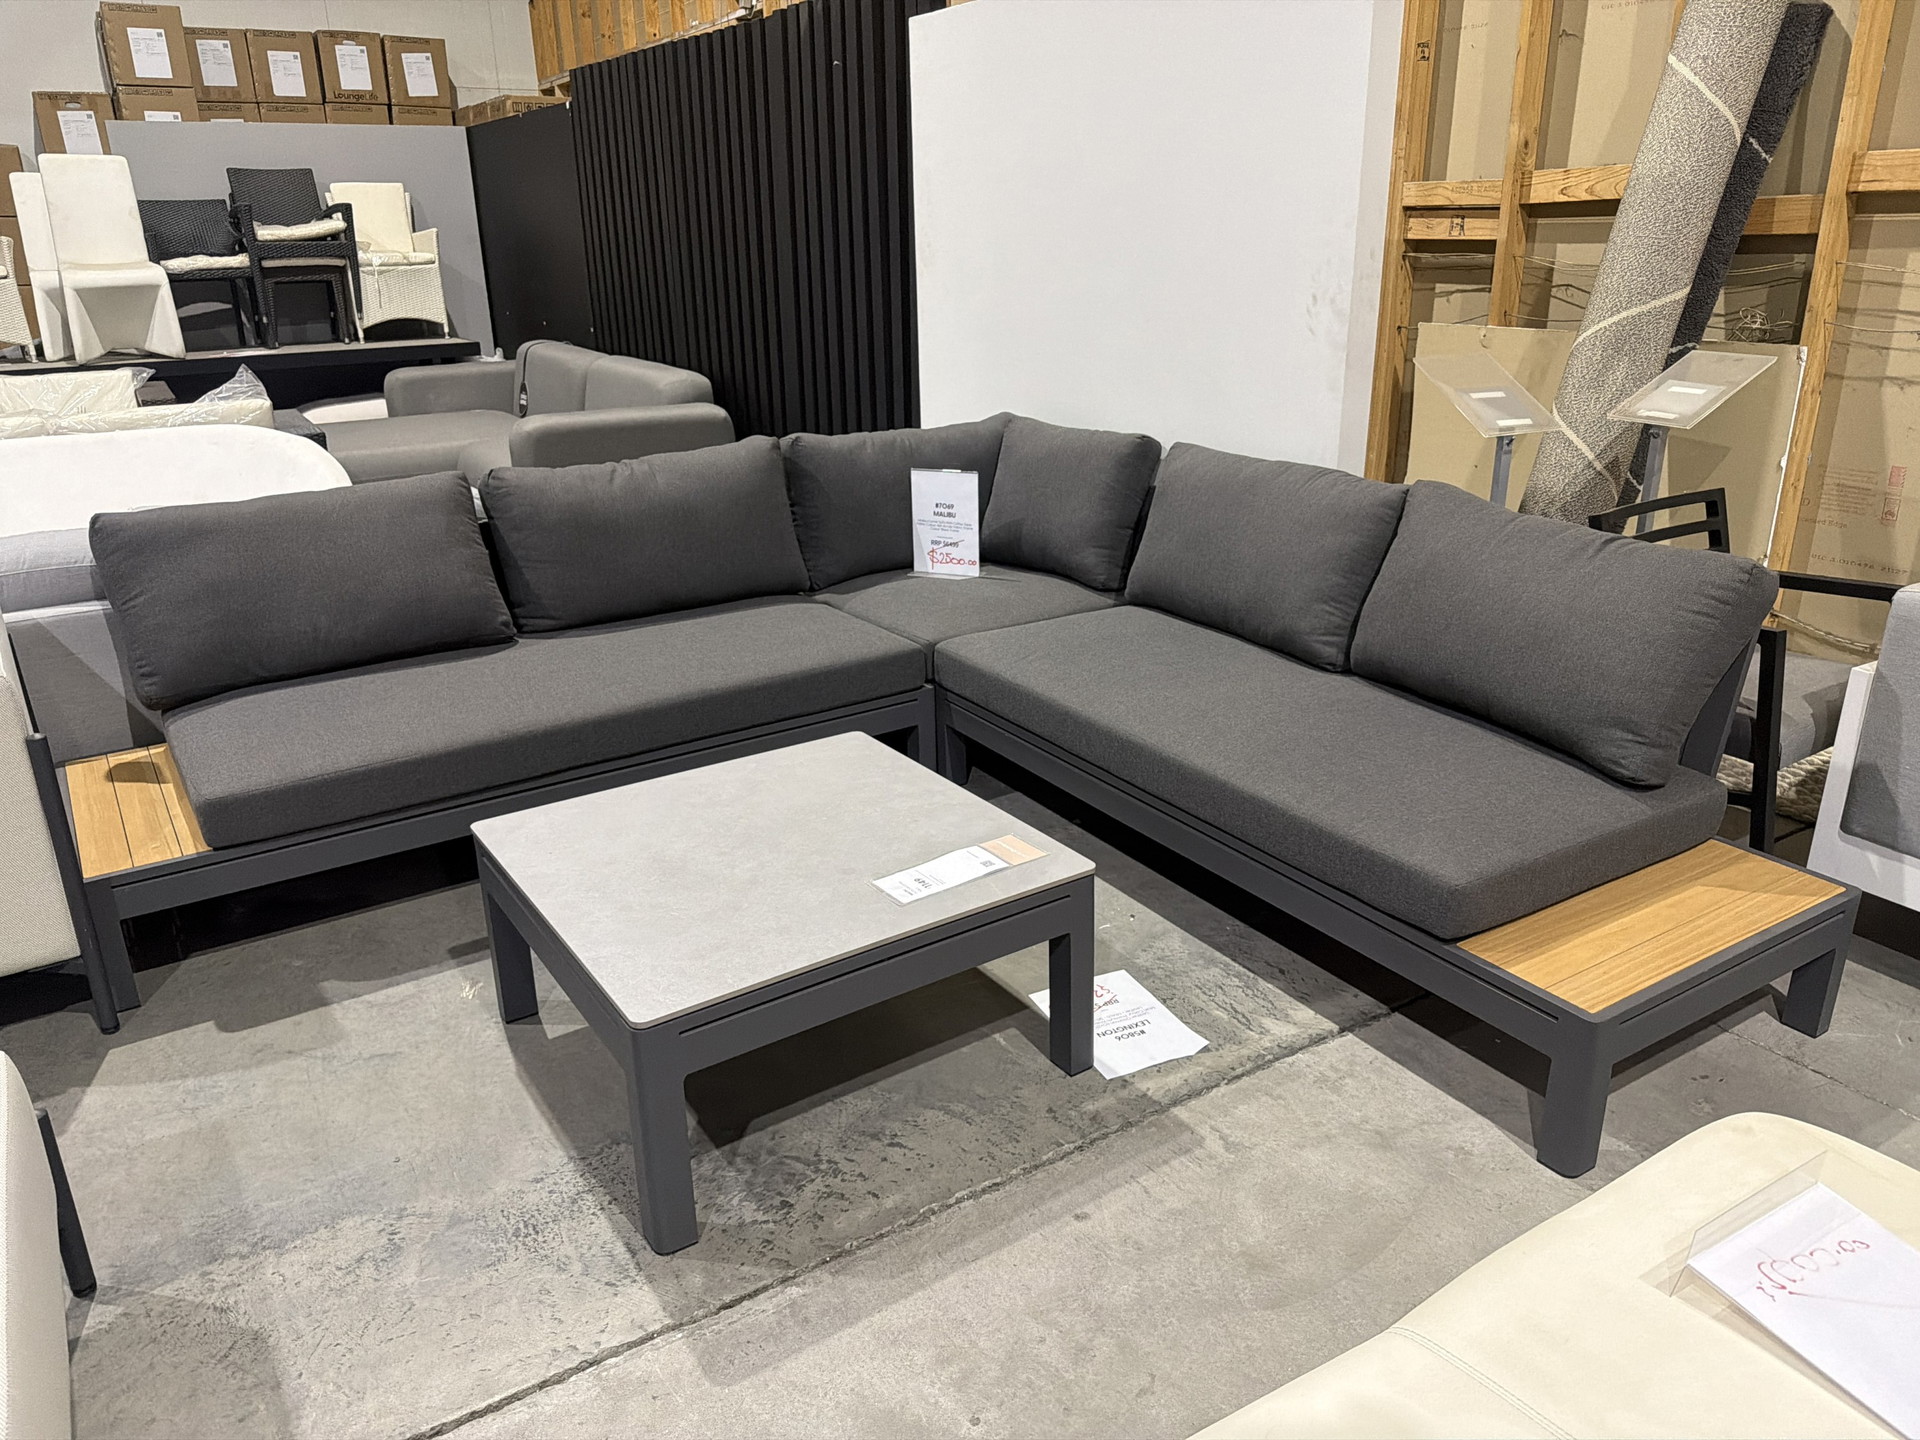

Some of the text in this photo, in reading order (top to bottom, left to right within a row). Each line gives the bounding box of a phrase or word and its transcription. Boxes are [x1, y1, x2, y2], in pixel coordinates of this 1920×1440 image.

[333, 90, 378, 101] LoungeLife
[927, 547, 977, 570] $2500.00
[1096, 1018, 1151, 1038] LEXINGTON
